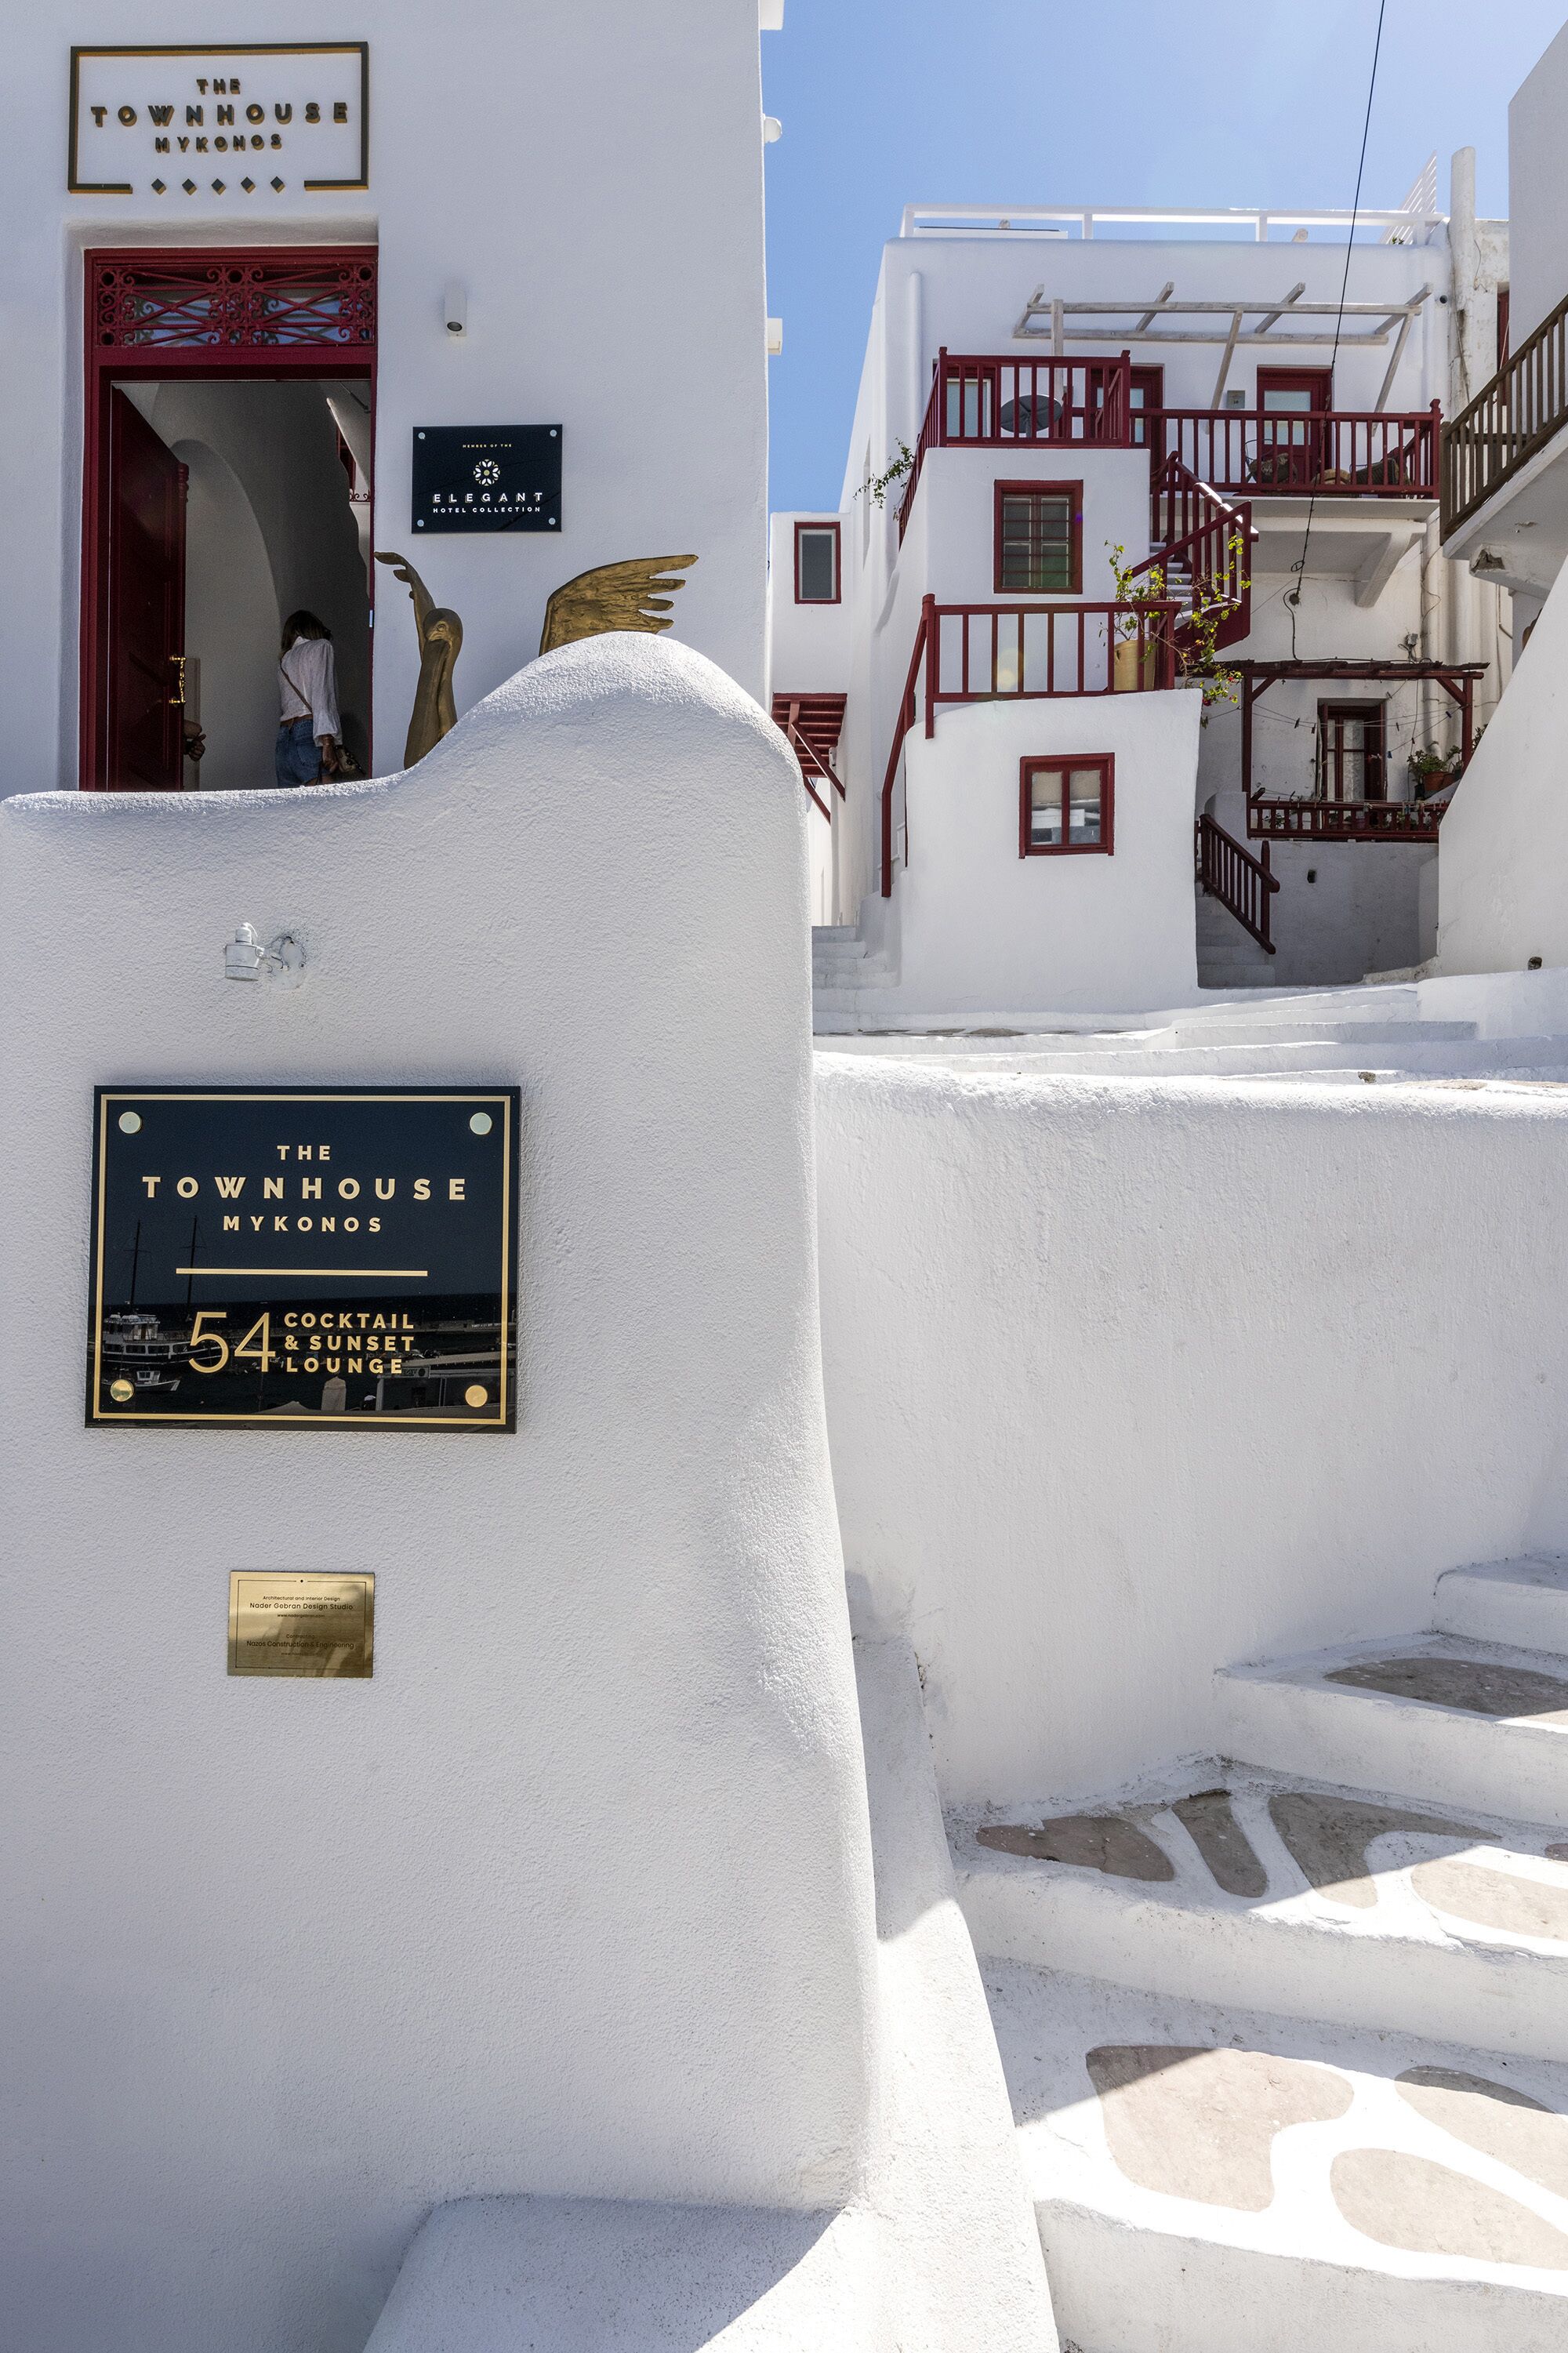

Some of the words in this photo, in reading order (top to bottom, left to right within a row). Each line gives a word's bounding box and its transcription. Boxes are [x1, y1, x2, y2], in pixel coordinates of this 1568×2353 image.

[196, 78, 241, 95] THE
[91, 102, 348, 128] TOWNHOUSE
[154, 133, 282, 154] MYKONOS
[433, 492, 543, 503] ELEGANT
[277, 1145, 331, 1160] THE
[142, 1175, 466, 1201] TOWNHOUSE
[223, 1215, 382, 1233] MYKONOS
[284, 1313, 415, 1329] COCKTAIL
[187, 1311, 276, 1374] 54
[284, 1335, 299, 1351] &
[310, 1335, 416, 1352] SUNSET
[286, 1357, 402, 1374] LOUNGE
[303, 1603, 328, 1611] Design
